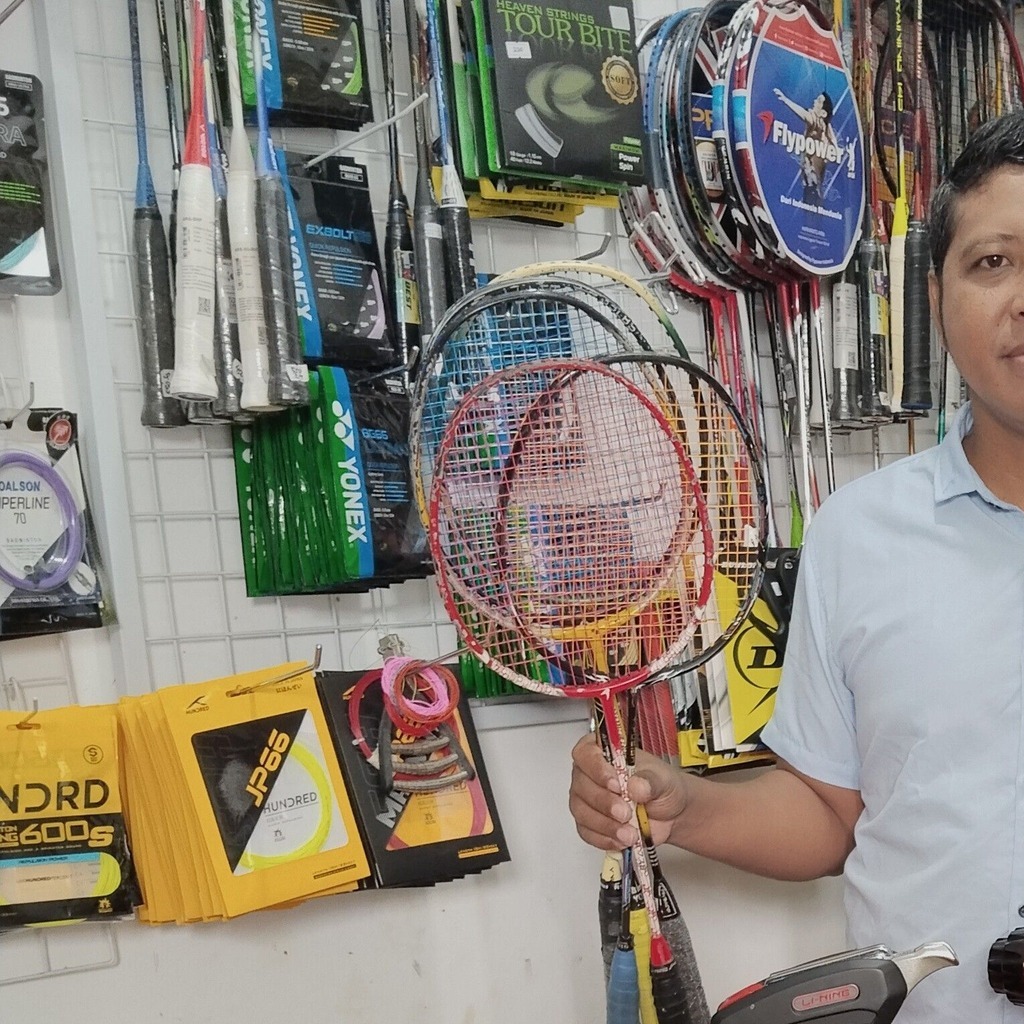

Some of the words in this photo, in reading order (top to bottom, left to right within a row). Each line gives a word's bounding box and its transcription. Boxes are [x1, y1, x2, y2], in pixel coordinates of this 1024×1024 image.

[496, 0, 543, 15] HEAVEN
[546, 7, 595, 25] STRINGS
[497, 9, 574, 42] TOUR
[578, 22, 633, 54] BITE
[610, 75, 632, 86] SOFT
[772, 121, 844, 164] Flypower
[618, 152, 640, 164] Power
[618, 162, 634, 172] Spin
[306, 223, 354, 240] EXBOLT
[0, 496, 50, 509] PERLINE
[338, 456, 368, 544] YONEX
[14, 512, 26, 524] 70
[245, 728, 290, 808] JP66
[263, 791, 318, 815] HUNDRED
[801, 989, 850, 1007] LI-NING
